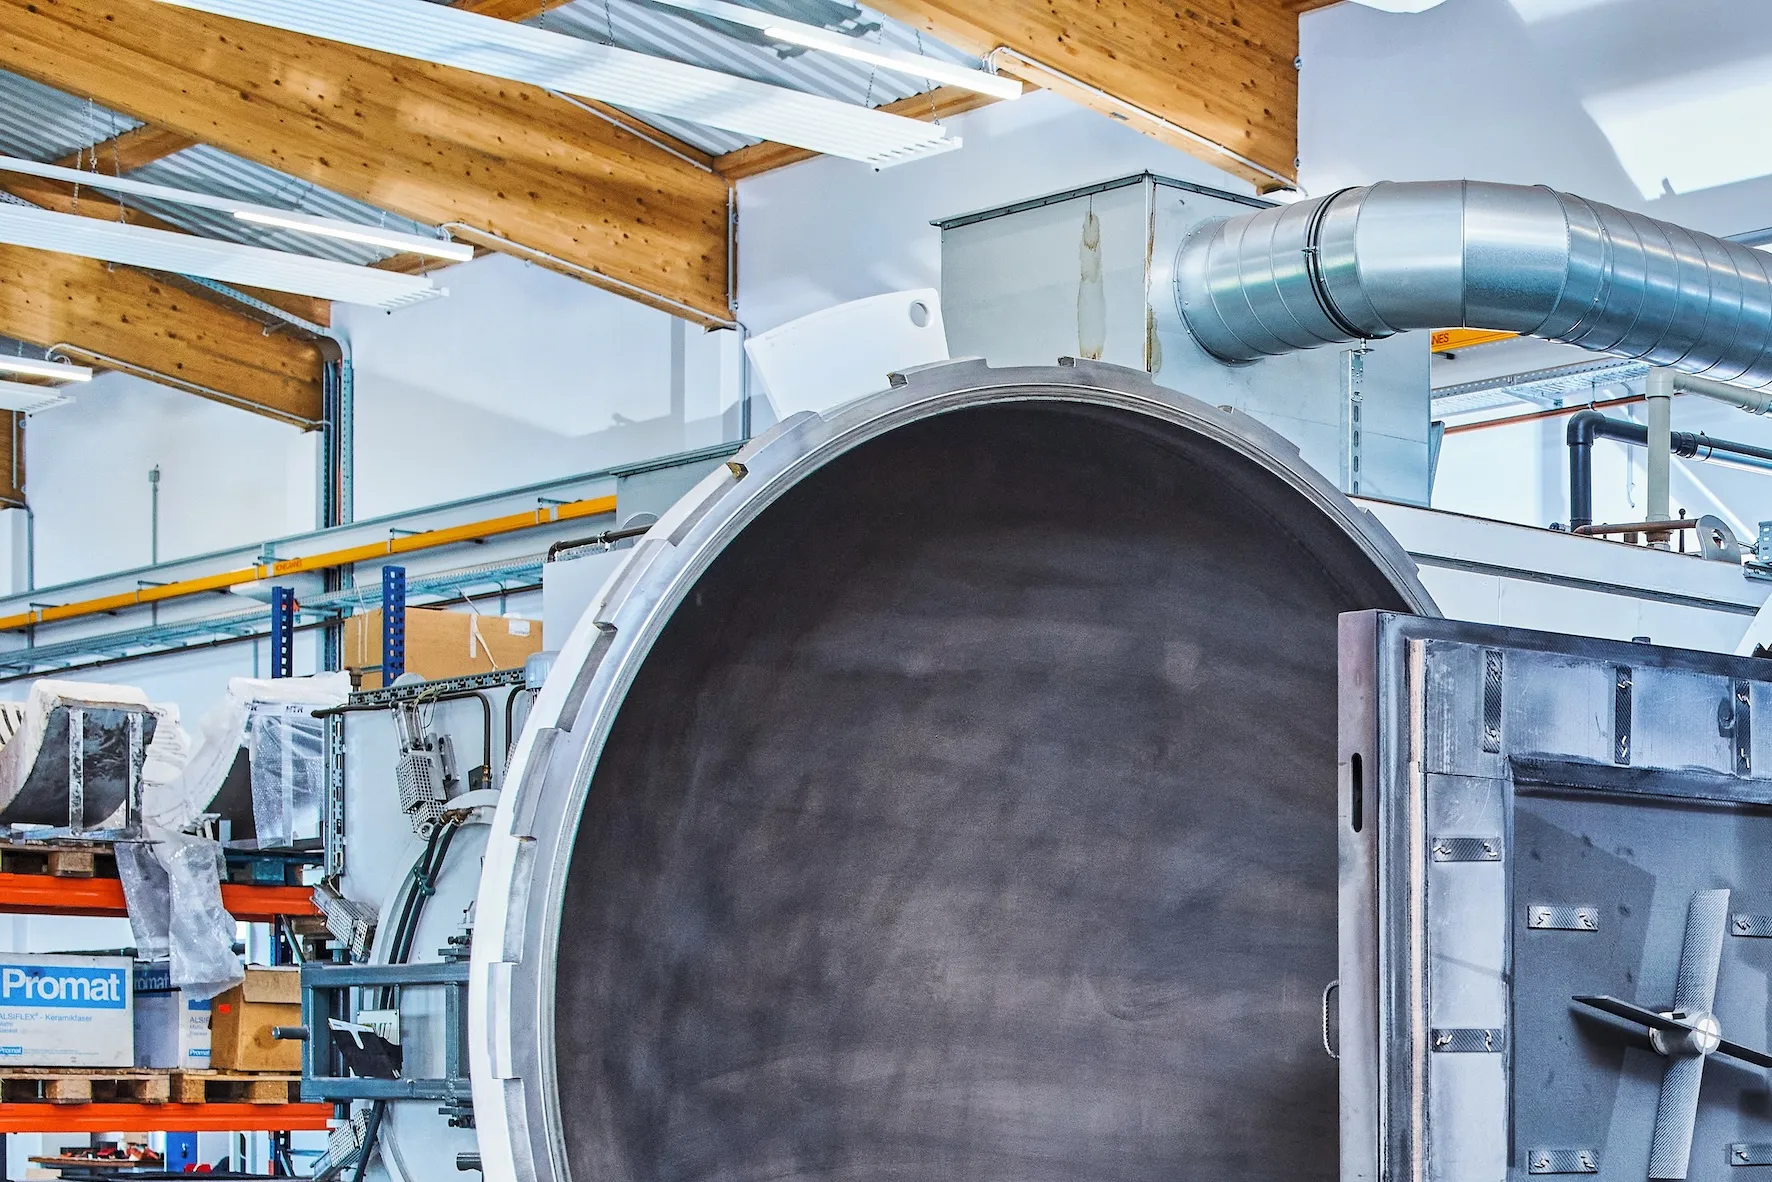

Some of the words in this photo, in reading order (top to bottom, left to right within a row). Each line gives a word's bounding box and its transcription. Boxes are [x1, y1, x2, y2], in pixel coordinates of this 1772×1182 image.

[3, 968, 120, 1001] Promat
[134, 973, 170, 990] romat
[189, 1016, 209, 1024] ALSIF
